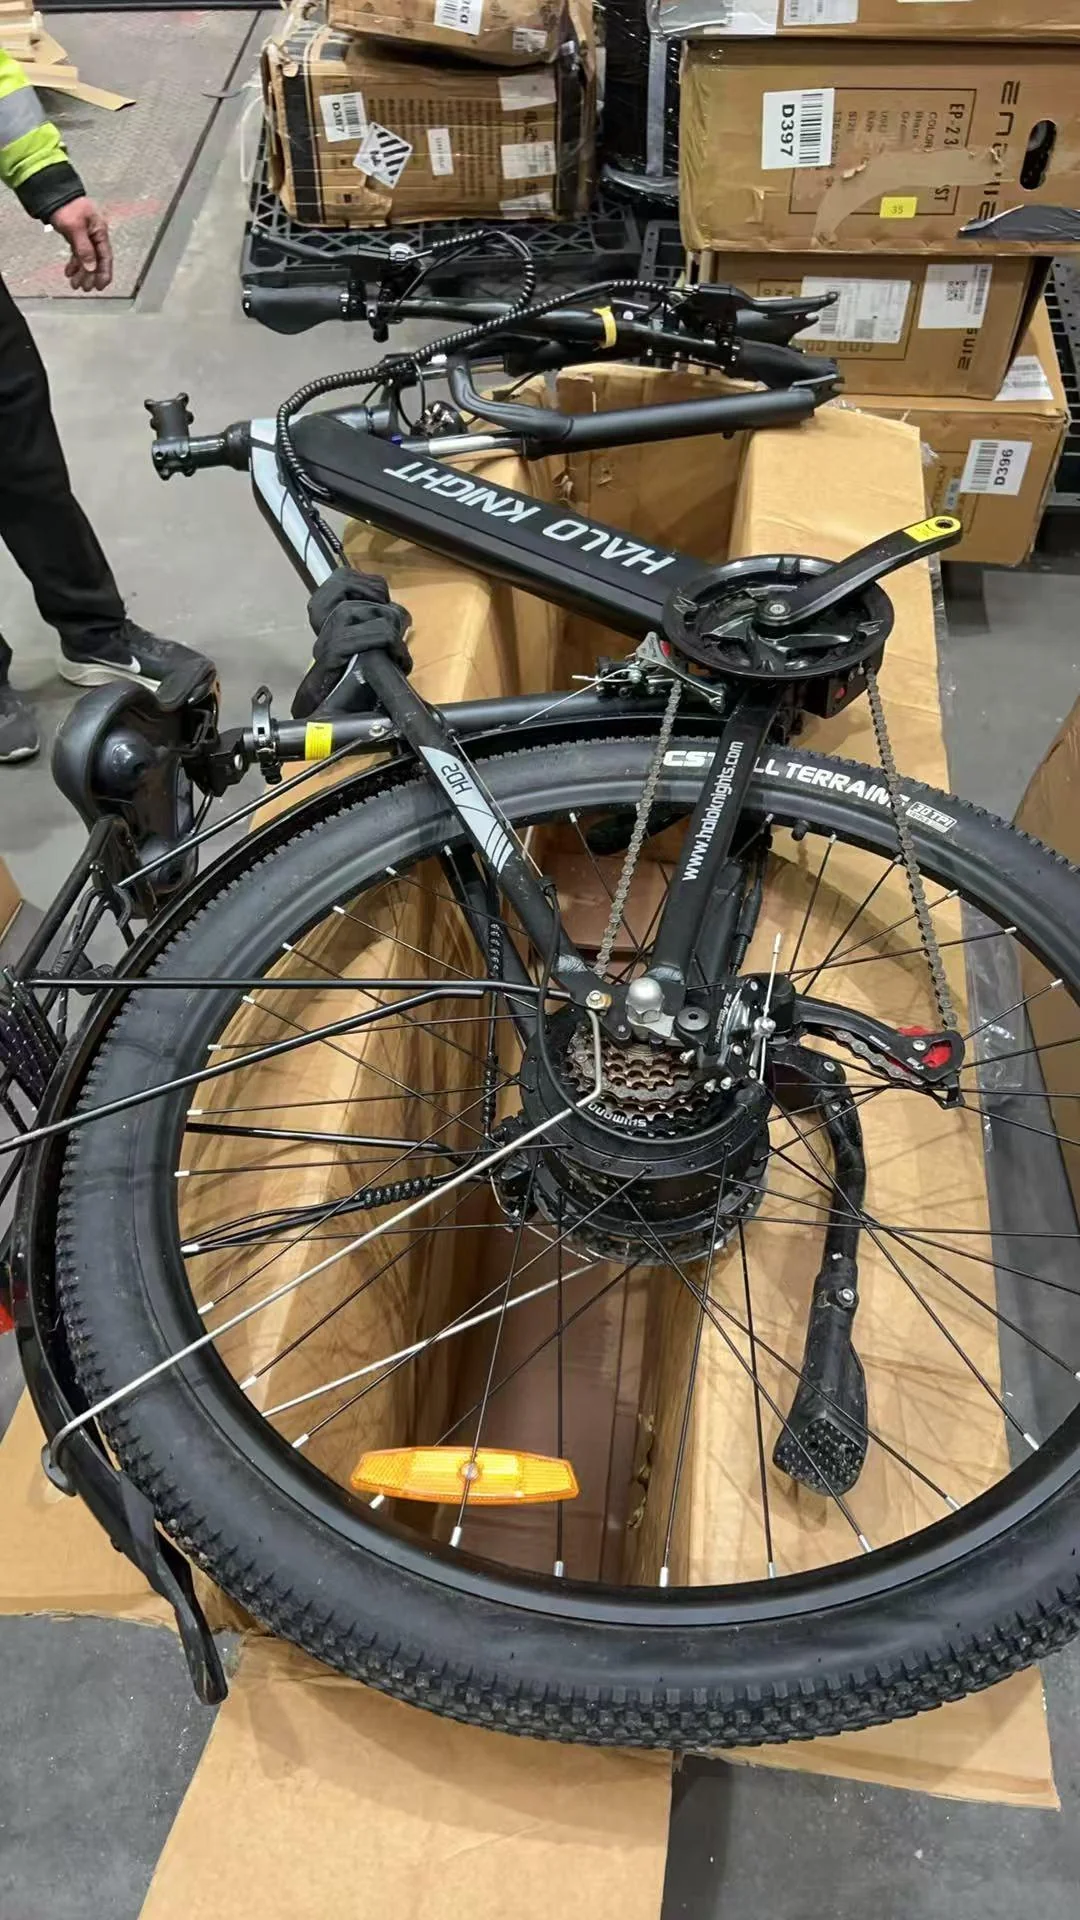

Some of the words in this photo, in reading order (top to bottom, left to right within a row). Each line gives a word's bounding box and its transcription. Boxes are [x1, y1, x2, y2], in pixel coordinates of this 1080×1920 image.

[780, 103, 795, 157] D397
[993, 448, 1014, 486] D396
[383, 461, 541, 524] KNIGHT
[542, 519, 676, 576] HALO
[441, 762, 473, 795] 20H
[682, 741, 744, 881] www.haloknights.com
[930, 811, 954, 827] TPI
[588, 1102, 647, 1128] SHIMANO
